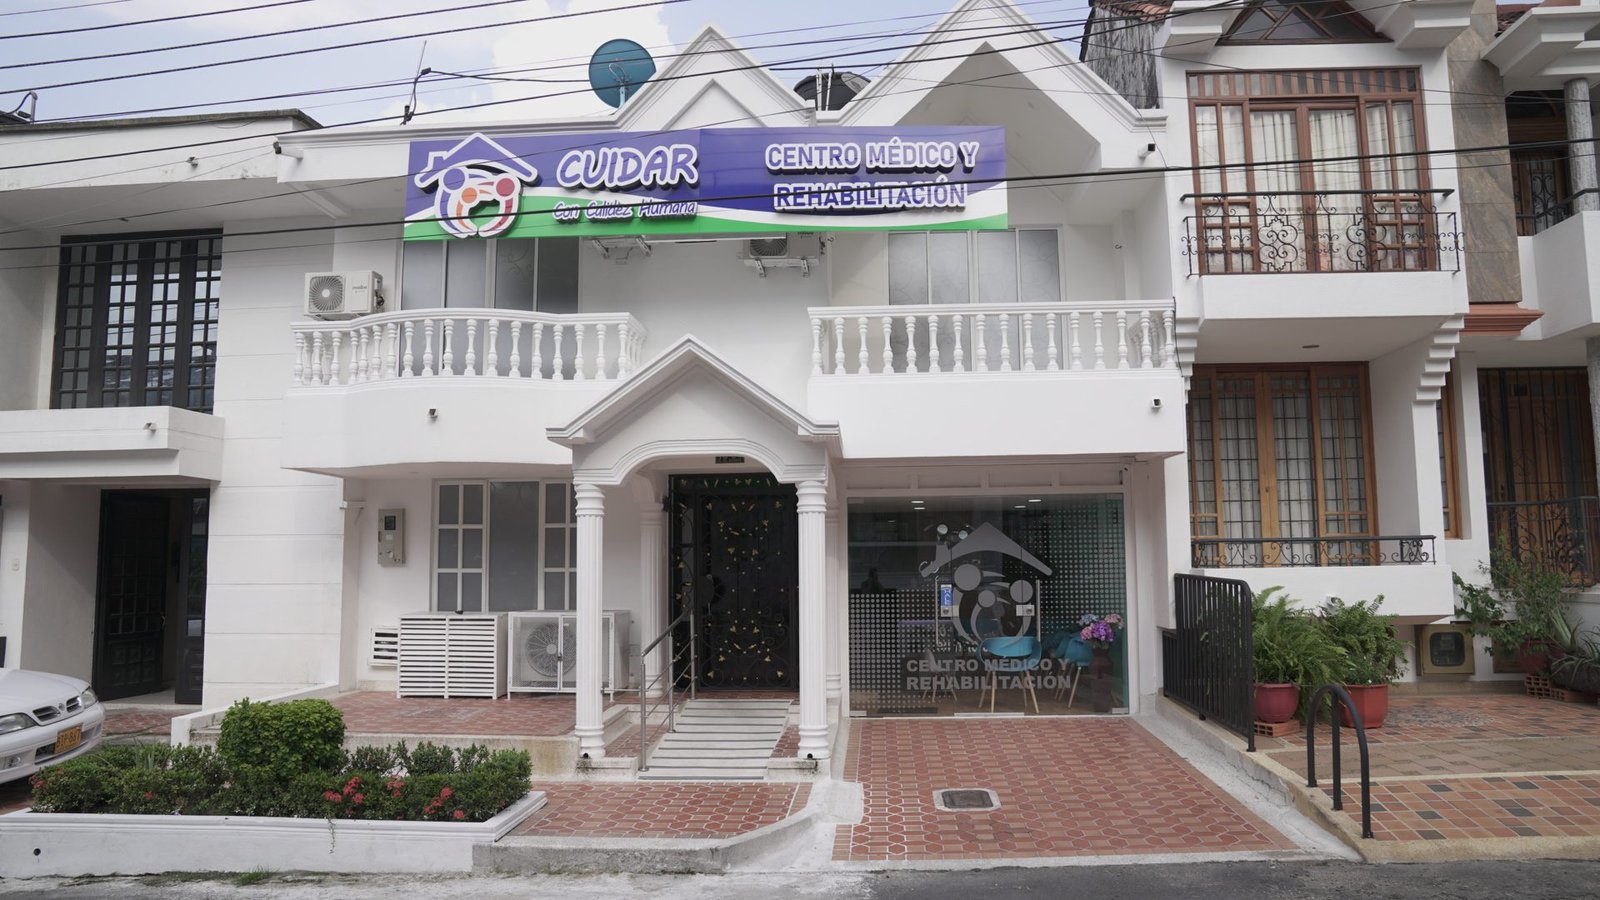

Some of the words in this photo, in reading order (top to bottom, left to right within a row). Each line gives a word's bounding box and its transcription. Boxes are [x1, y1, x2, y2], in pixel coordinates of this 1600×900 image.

[557, 143, 699, 188] CUIDAR
[766, 143, 861, 169] CENTRO
[866, 136, 957, 168] MÉDICO
[959, 141, 979, 167] Y
[774, 175, 967, 210] REHABILITACIÓN
[553, 201, 579, 219] Con
[585, 200, 633, 218] Calidez
[638, 199, 698, 217] Humana
[906, 658, 979, 673] CENTRO
[984, 656, 1053, 672] MÉDICO
[1055, 658, 1069, 671] Y
[906, 672, 1071, 690] REHABILITACIÓN
